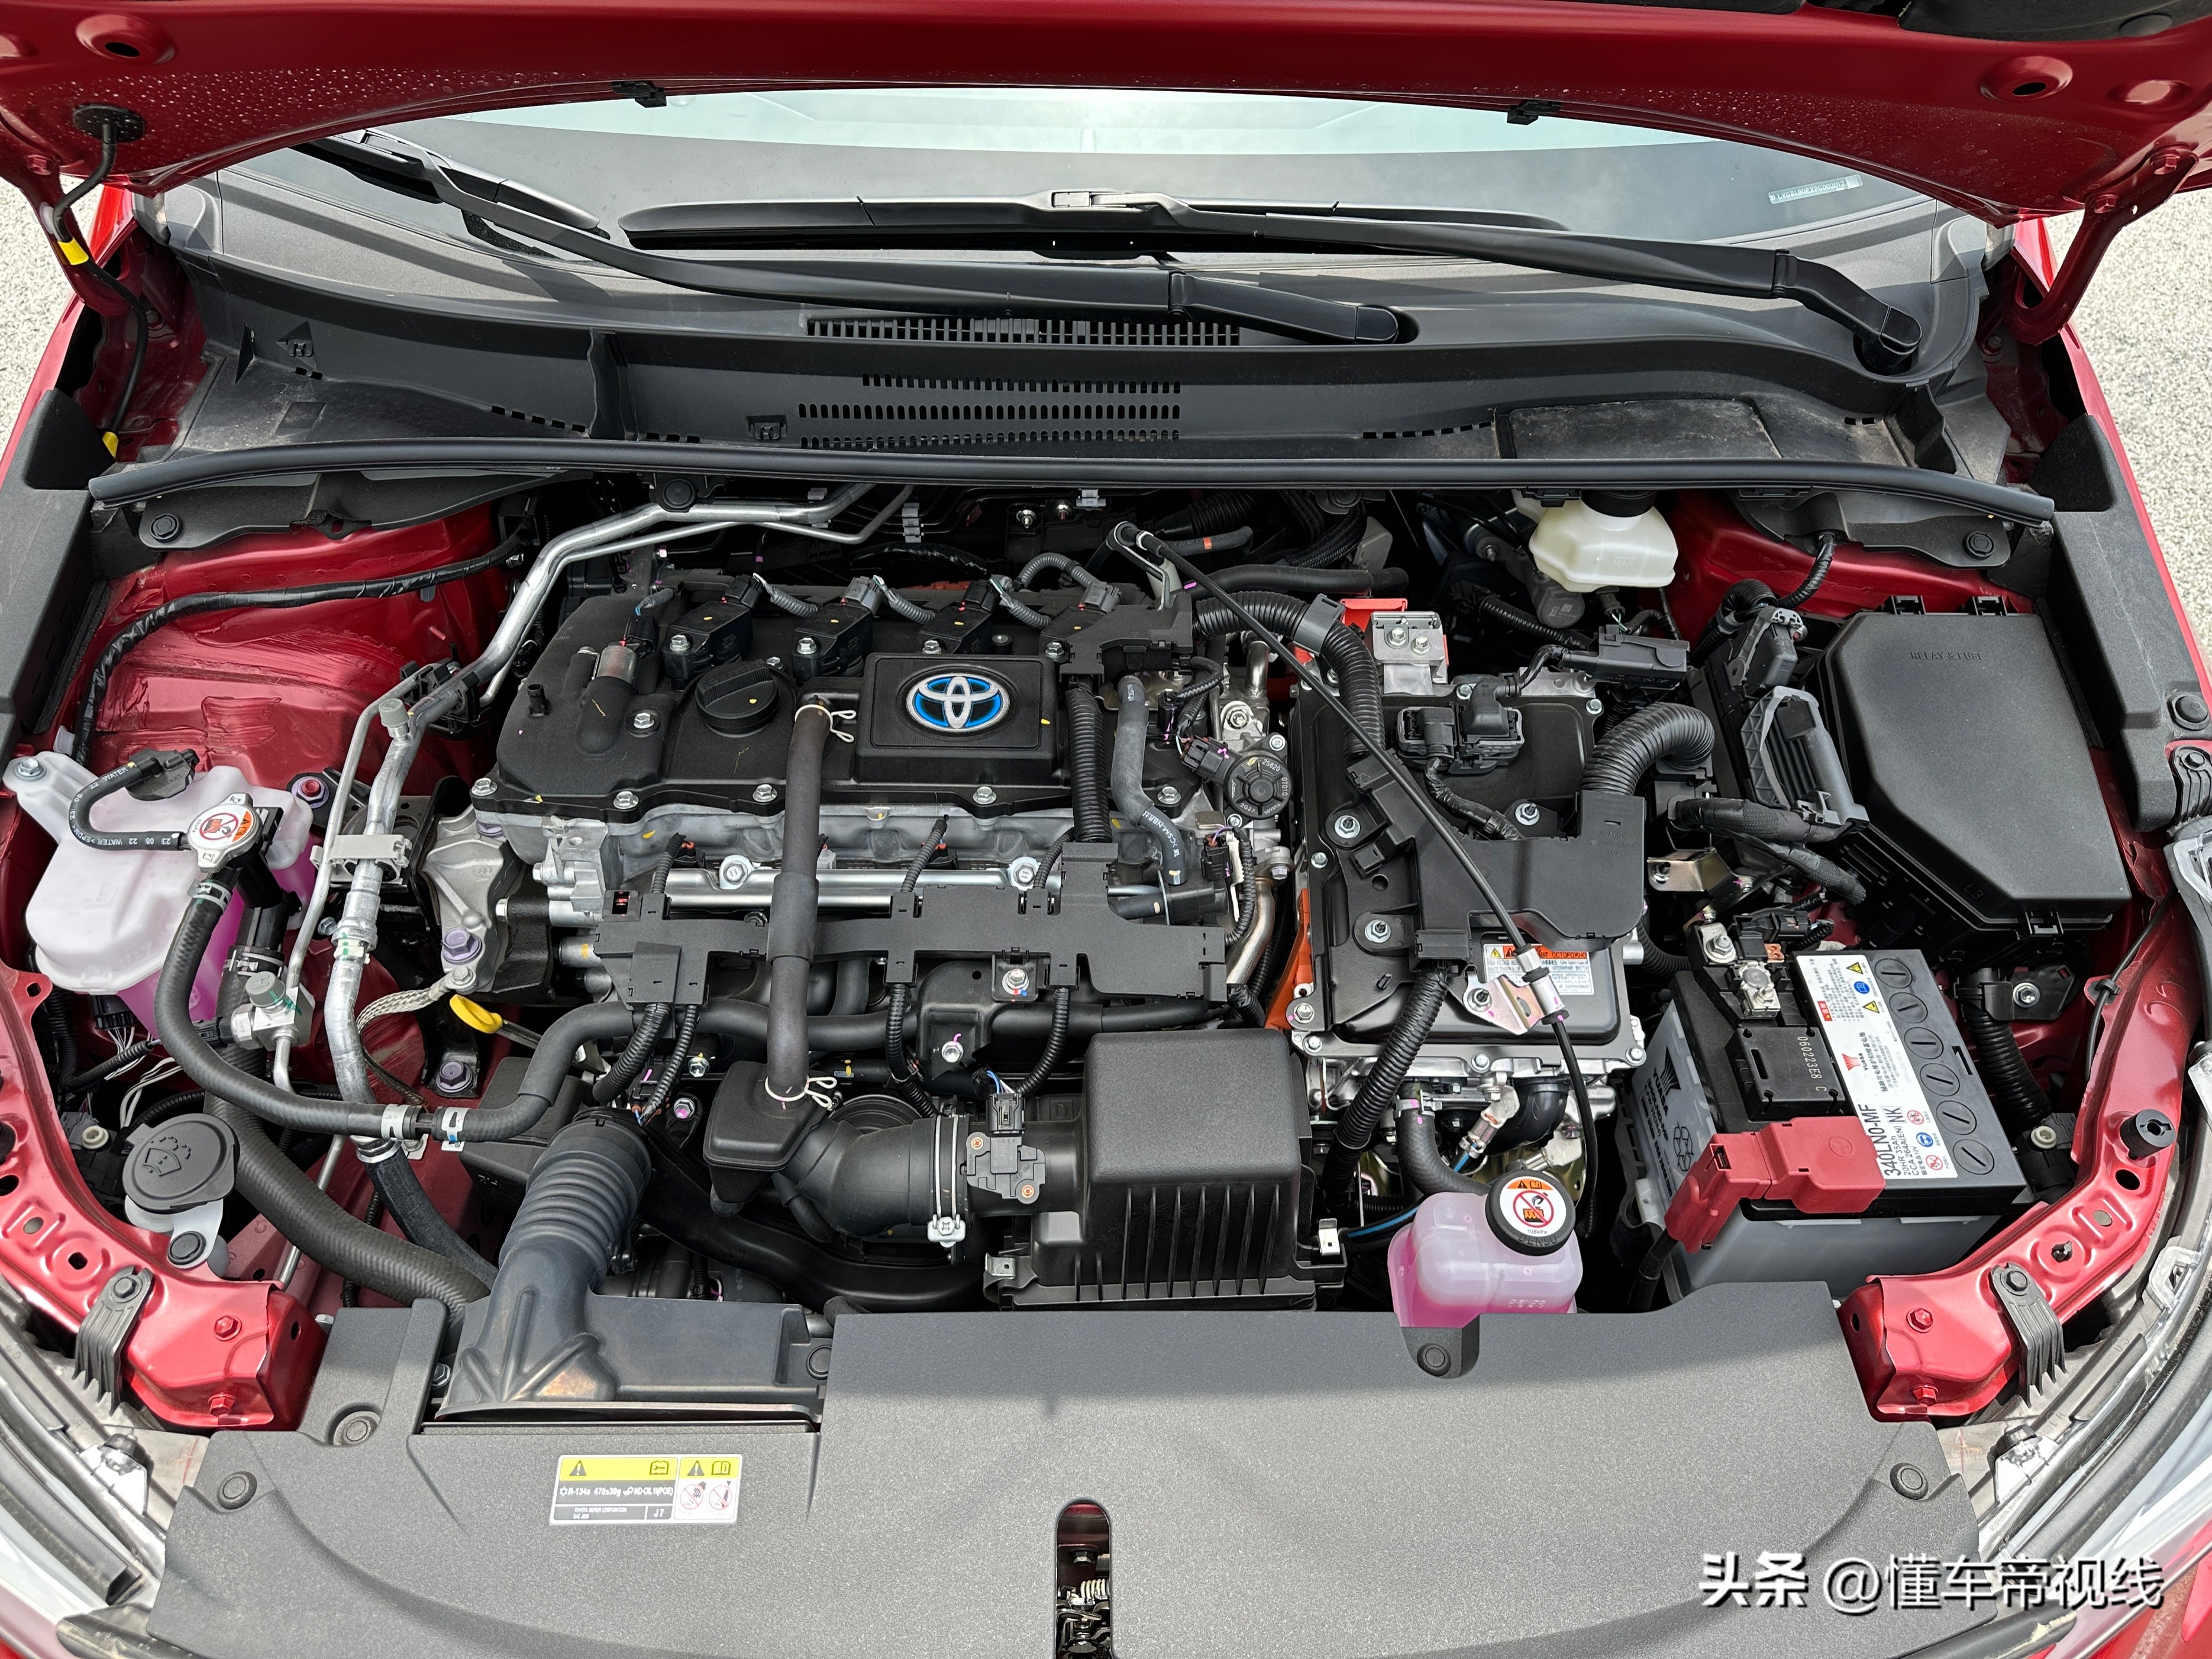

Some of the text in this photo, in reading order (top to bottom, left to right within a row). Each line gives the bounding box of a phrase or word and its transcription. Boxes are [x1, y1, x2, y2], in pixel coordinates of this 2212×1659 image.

[1910, 651, 1985, 660] RELAY & FUSE
[89, 782, 100, 790] 22
[102, 767, 129, 782] WATER
[1239, 803, 1256, 813] 2G27
[1264, 803, 1281, 815] TOYOTA
[1964, 883, 1984, 900] L3
[1797, 1036, 1823, 1079] 060223E8
[1653, 1067, 1668, 1117] YUASA
[1888, 1107, 1904, 1123] NK
[1897, 1126, 1920, 1176] CCA 264A(EN)
[1902, 1156, 1911, 1175] 20HR
[1517, 1235, 1558, 1247] DENSO
[567, 1487, 590, 1496] R-134a
[593, 1487, 621, 1497] 470±30g
